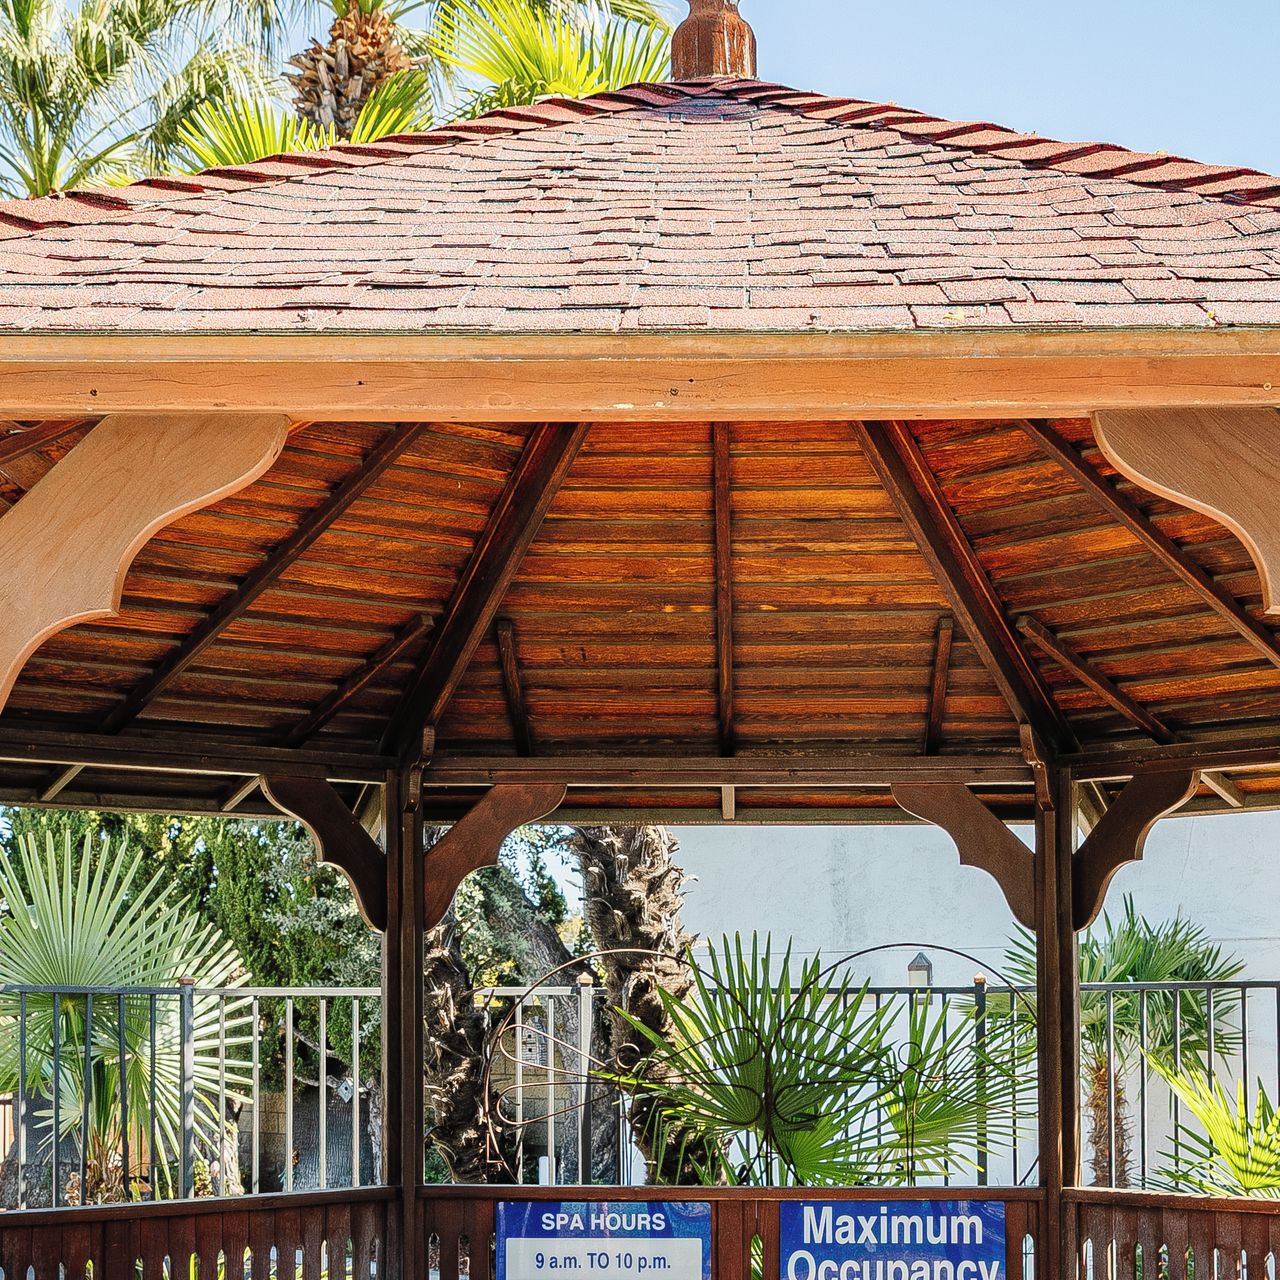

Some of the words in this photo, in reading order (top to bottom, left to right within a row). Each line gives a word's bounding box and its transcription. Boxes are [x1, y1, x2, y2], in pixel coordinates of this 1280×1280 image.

[541, 1213, 584, 1231] SPA
[590, 1213, 666, 1231] HOURS
[803, 1206, 983, 1245] Maximum
[535, 1252, 545, 1270] 9
[549, 1256, 582, 1270] a.m.
[587, 1252, 610, 1270] TO
[615, 1252, 633, 1270] 10
[637, 1256, 671, 1274] p.m.
